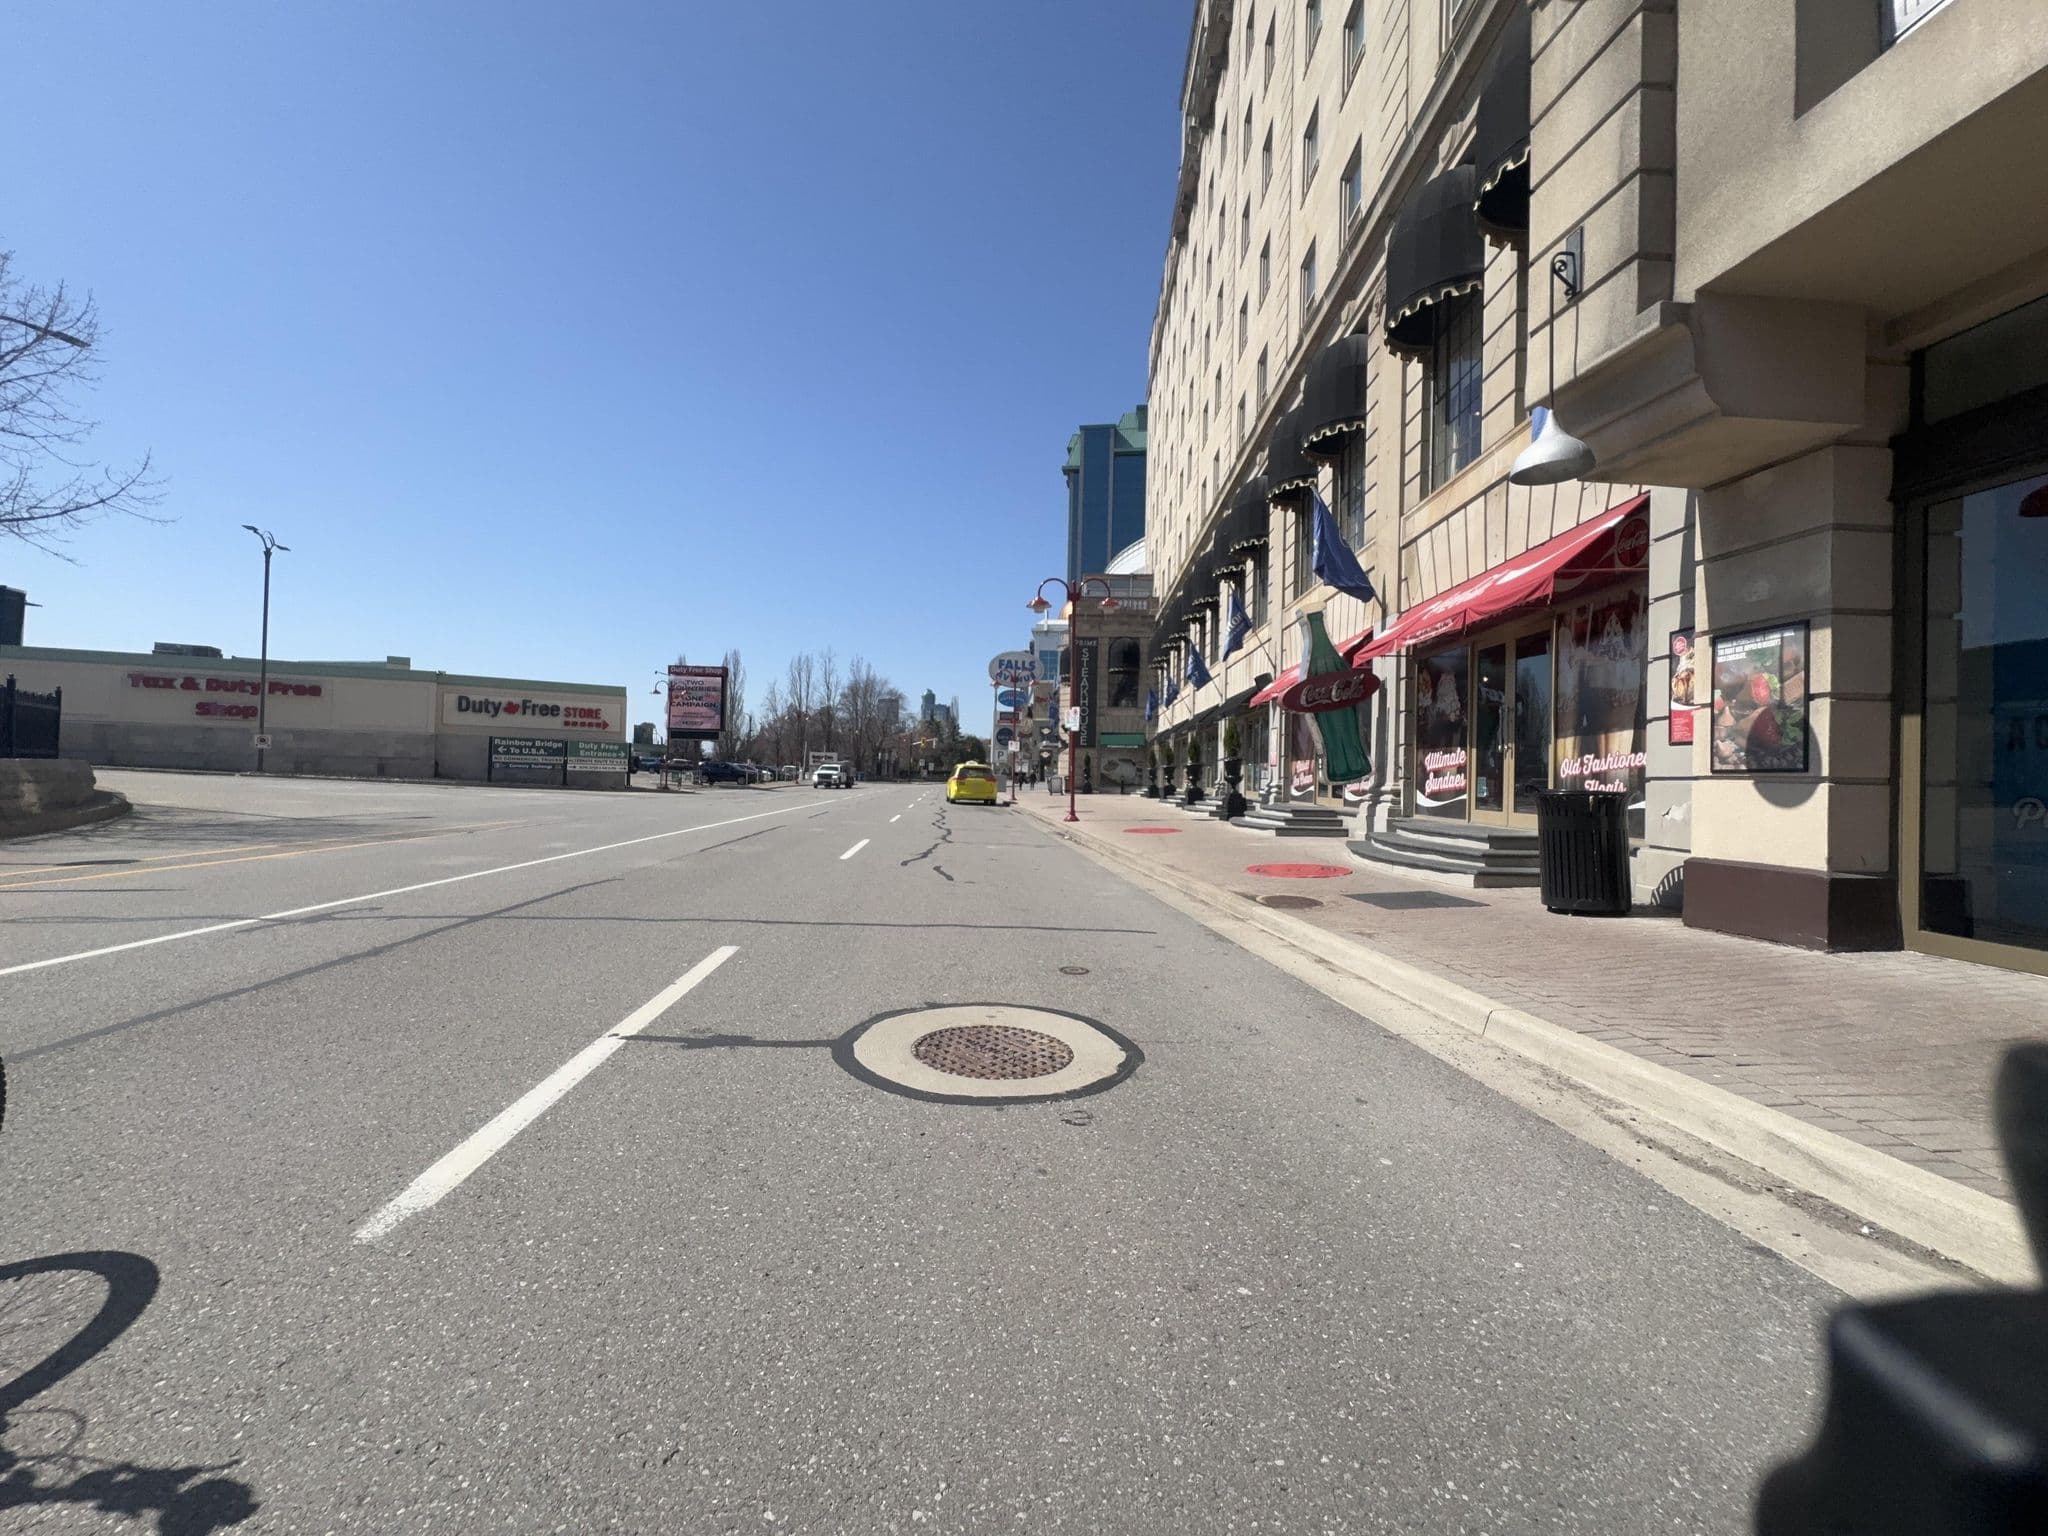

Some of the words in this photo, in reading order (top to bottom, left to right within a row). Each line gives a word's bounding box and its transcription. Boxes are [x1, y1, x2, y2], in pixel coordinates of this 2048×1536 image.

[998, 659, 1036, 671] FALLS
[127, 673, 177, 689] Tax
[180, 676, 200, 691] &
[205, 678, 261, 696] Duty
[268, 681, 322, 697] Free
[1079, 647, 1089, 746] STEAKHOUSE
[195, 701, 258, 719] Shop
[457, 695, 502, 718] Duty
[521, 699, 561, 717] Free
[564, 706, 602, 719] STORE
[494, 739, 532, 747] Rainbow
[535, 740, 563, 749] Bridge
[522, 747, 547, 755] U.S.A.
[578, 742, 598, 750] Duty
[1425, 747, 1467, 771] Ultimate
[1561, 758, 1582, 777] Old
[1425, 771, 1467, 796] Sundaes
